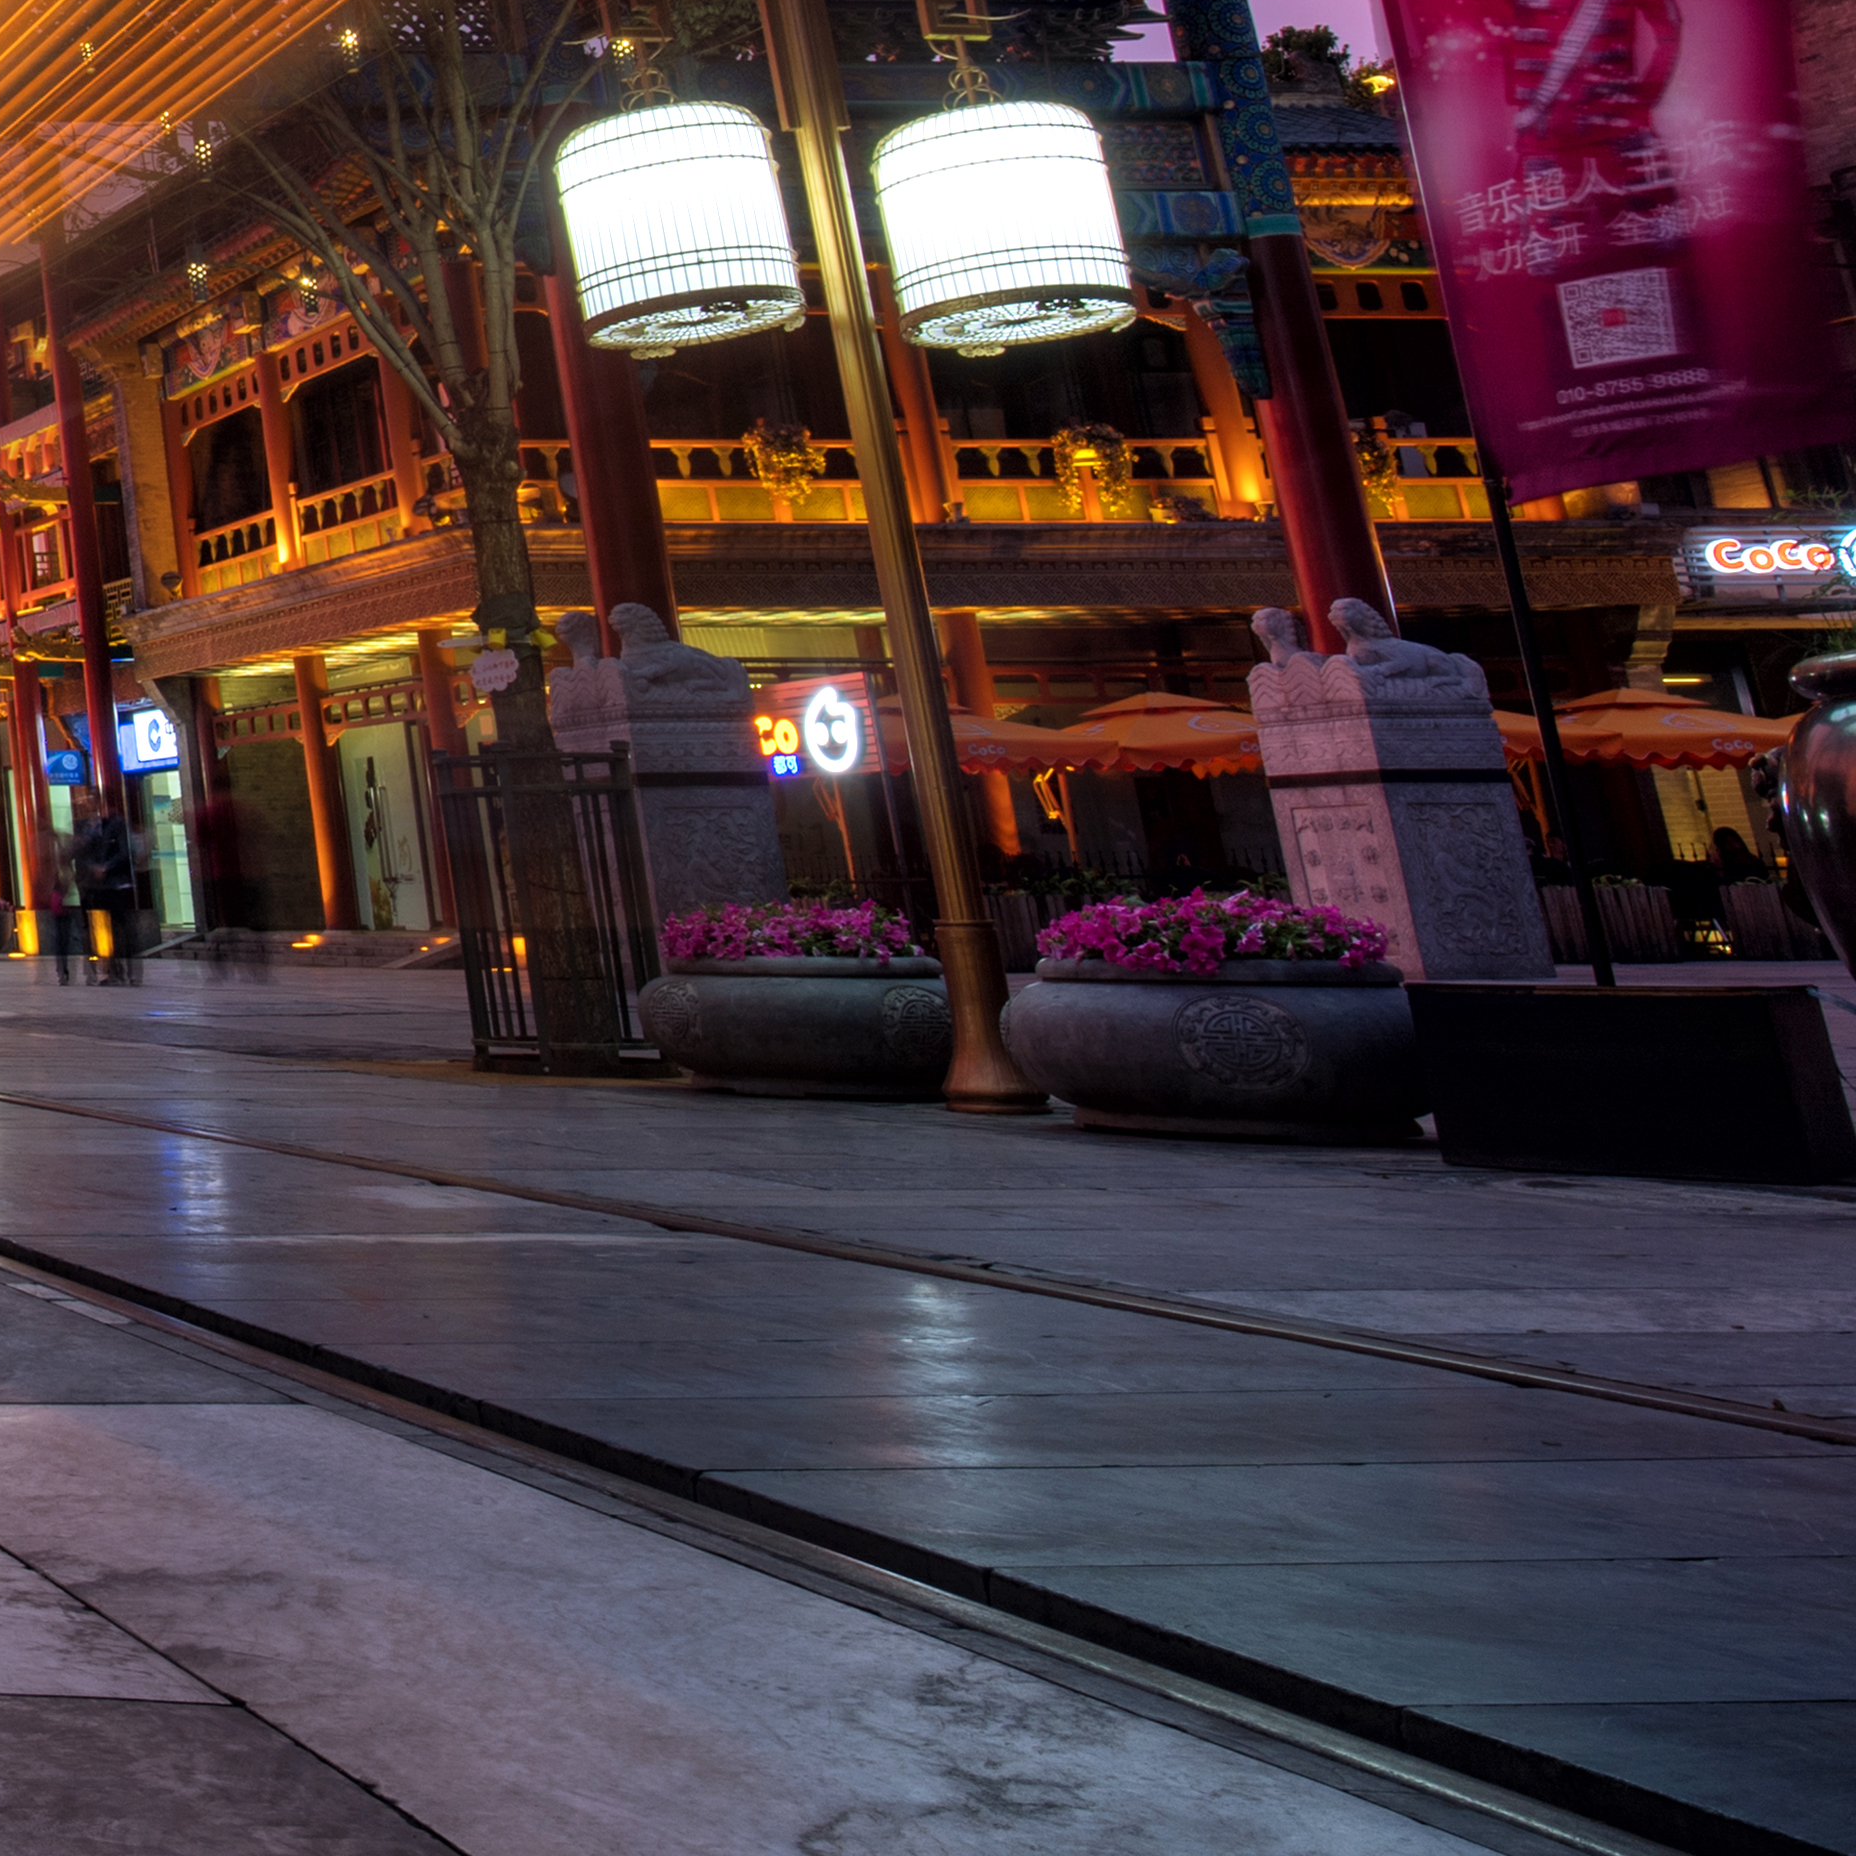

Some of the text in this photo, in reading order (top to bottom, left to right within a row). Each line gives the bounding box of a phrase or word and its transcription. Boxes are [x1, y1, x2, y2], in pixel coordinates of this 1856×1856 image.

[1705, 538, 1836, 574] CoCo
[967, 742, 1007, 756] CoCo
[1711, 738, 1754, 751] CoCo
